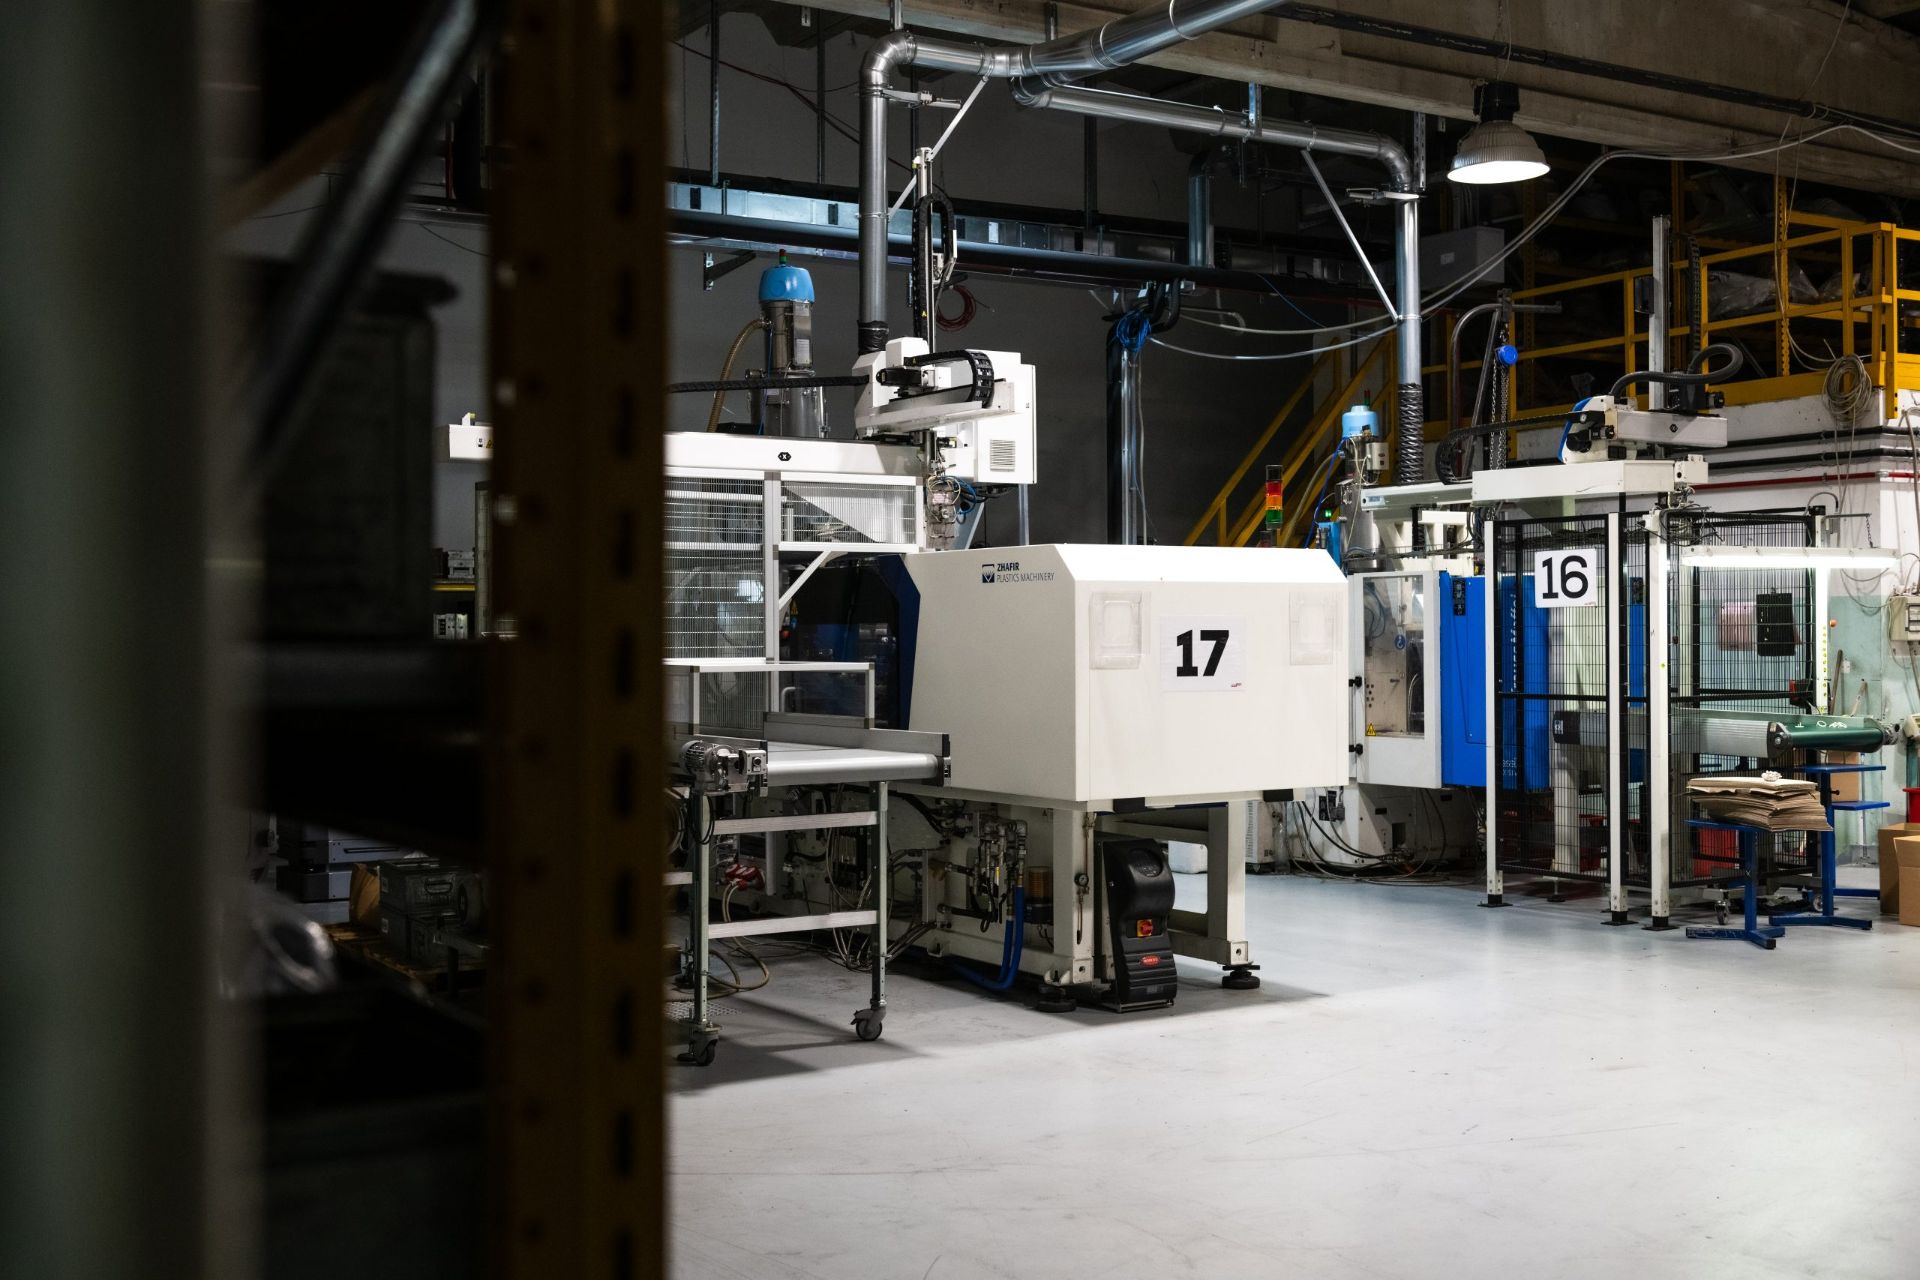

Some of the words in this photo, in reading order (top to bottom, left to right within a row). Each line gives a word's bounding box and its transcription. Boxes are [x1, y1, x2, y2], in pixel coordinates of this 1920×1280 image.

[997, 562, 1020, 572] ZHAFIR
[997, 574, 1020, 583] PLASTICS
[1021, 572, 1055, 582] MACHINERY
[1542, 555, 1588, 599] 16
[1176, 629, 1230, 677] 17
